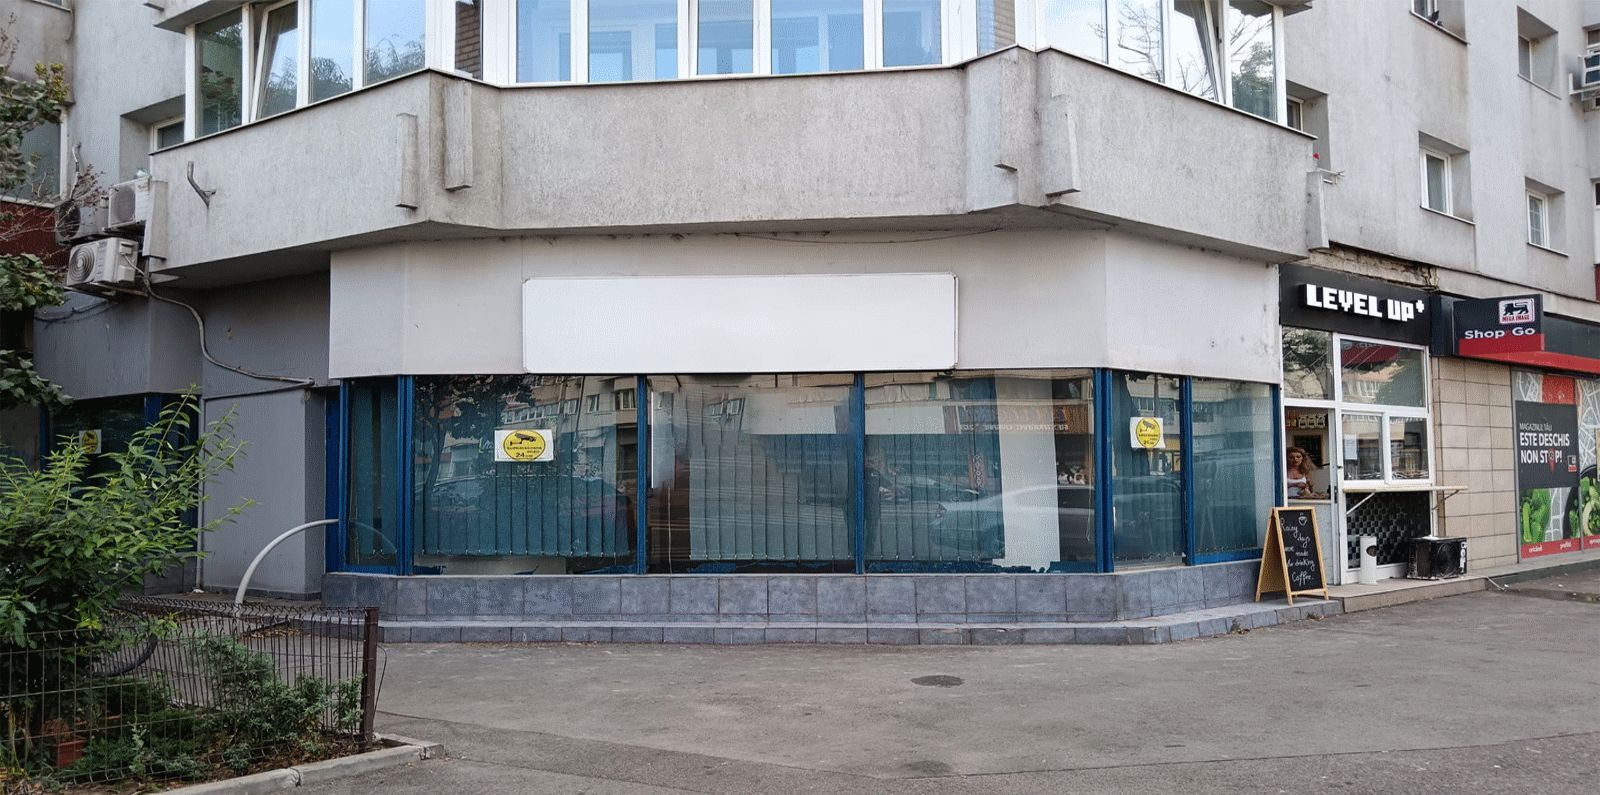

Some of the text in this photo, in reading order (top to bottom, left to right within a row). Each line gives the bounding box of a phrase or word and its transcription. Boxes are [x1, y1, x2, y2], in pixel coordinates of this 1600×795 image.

[1306, 283, 1383, 318] LEVEL
[1464, 326, 1536, 340] Shop Go
[1519, 432, 1570, 447] ESTE DESCHIS
[1520, 449, 1539, 464] NON
